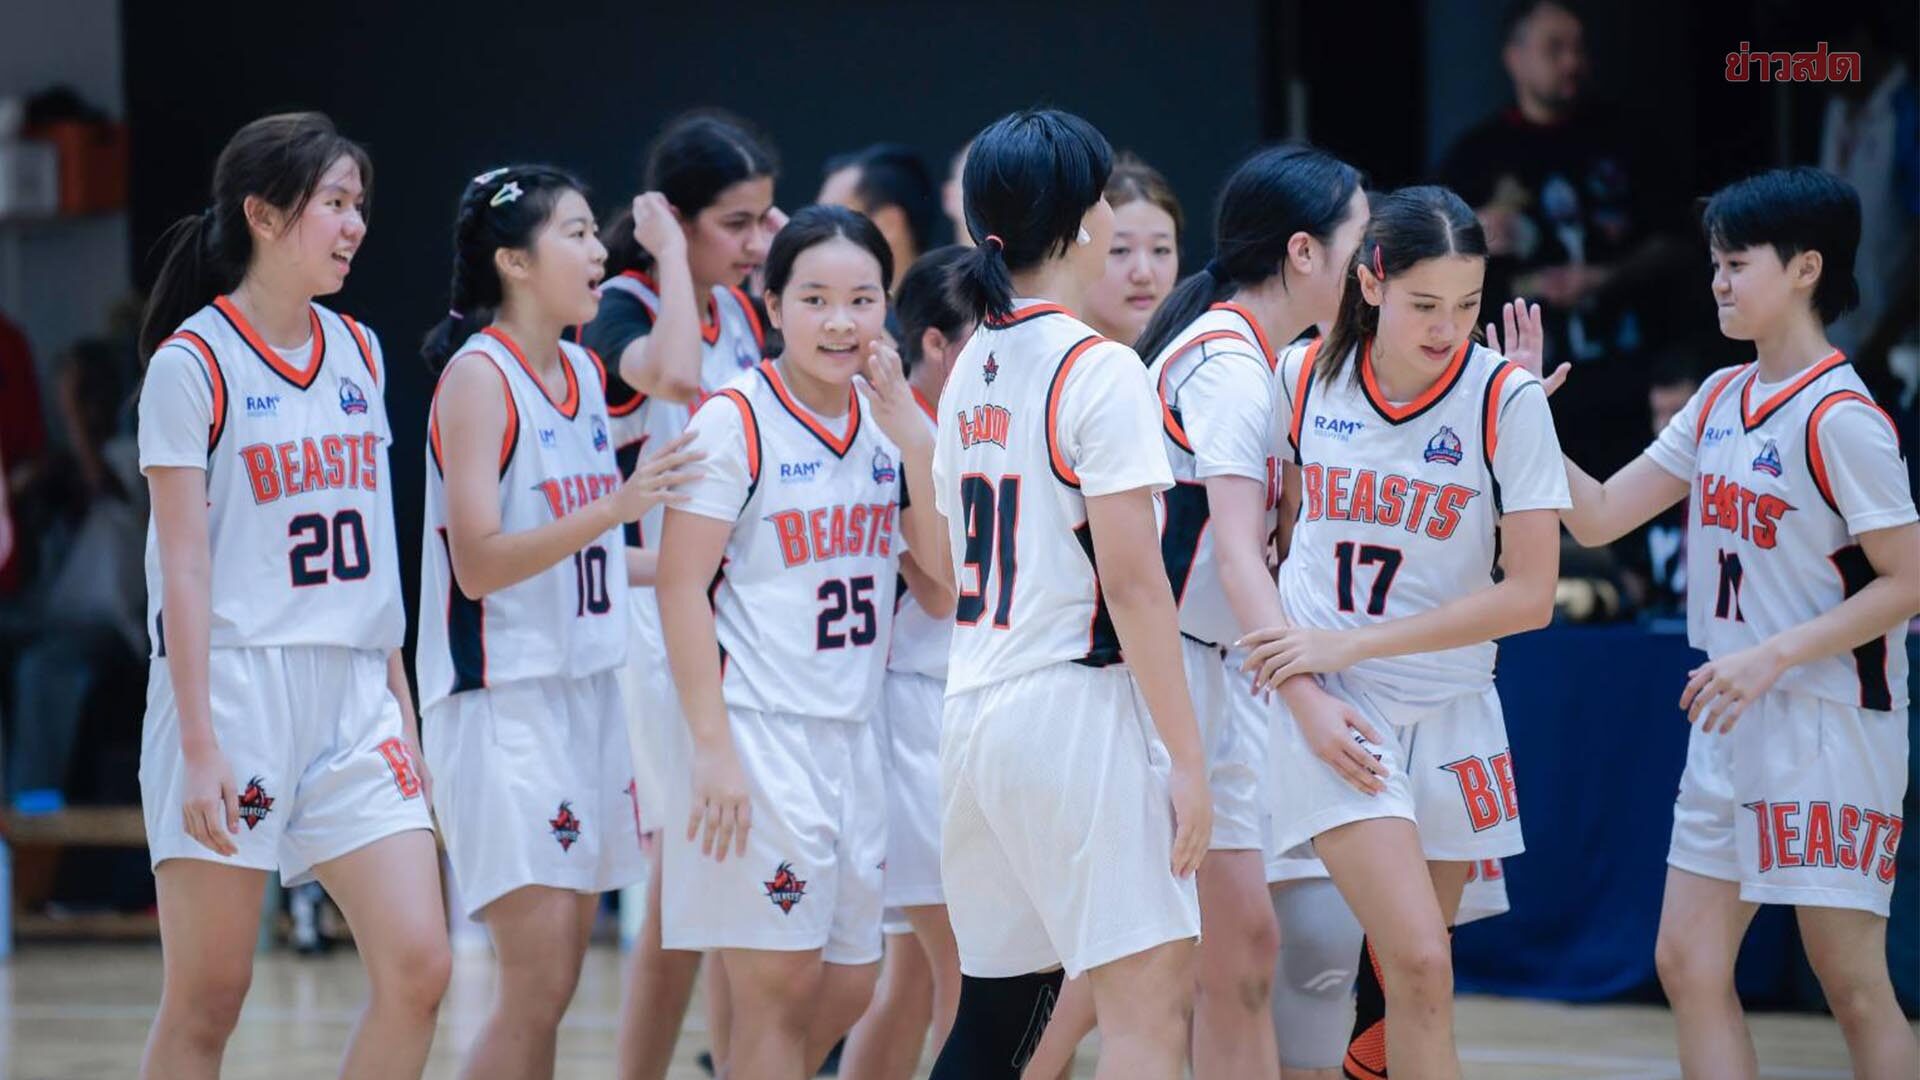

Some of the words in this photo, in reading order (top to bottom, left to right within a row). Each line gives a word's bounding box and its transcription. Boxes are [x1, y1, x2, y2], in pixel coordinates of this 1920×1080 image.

[1314, 415, 1354, 435] RAM
[239, 431, 382, 505] BEASTS
[780, 462, 815, 476] RAM
[1302, 462, 1480, 540] BEASTS
[288, 508, 371, 588] 20
[763, 500, 896, 568] BEASTS
[1699, 472, 1798, 549] EASTS
[574, 545, 611, 618] 10
[956, 472, 1021, 630] 91
[1334, 541, 1404, 616] 17
[816, 574, 876, 651] 25
